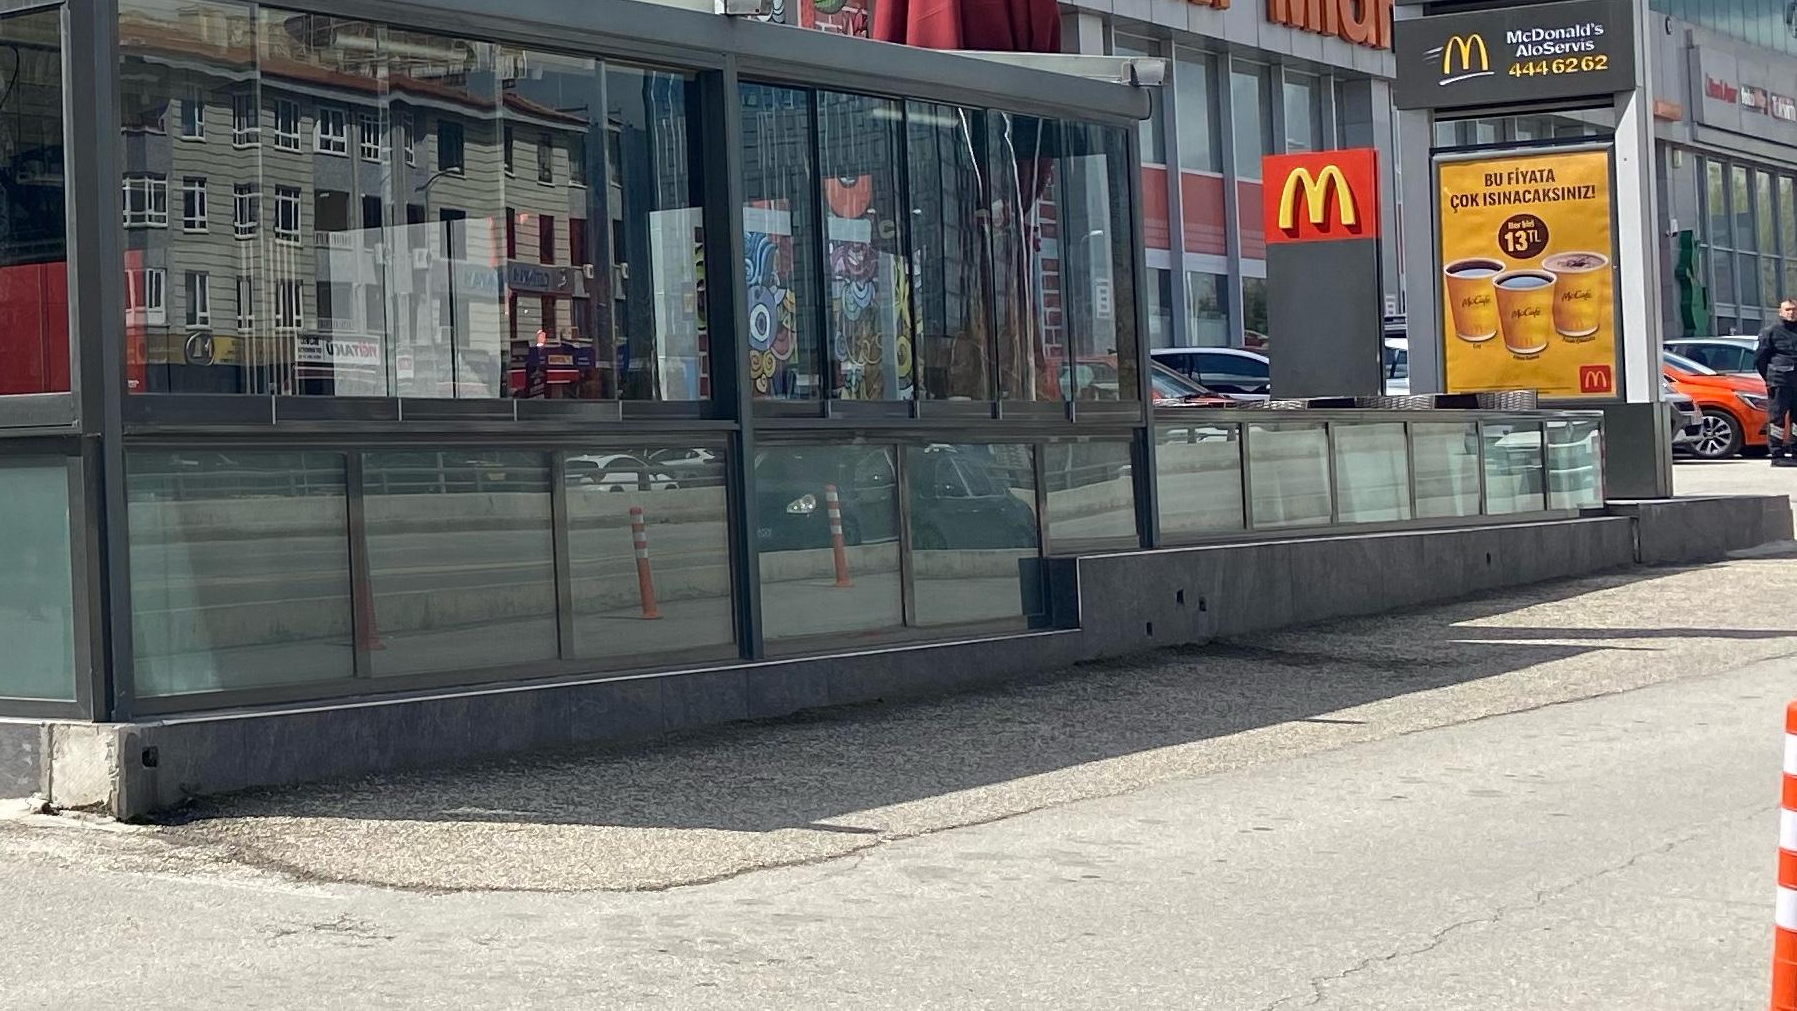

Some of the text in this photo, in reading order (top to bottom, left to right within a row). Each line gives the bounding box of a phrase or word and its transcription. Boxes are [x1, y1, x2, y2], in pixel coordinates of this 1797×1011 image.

[1506, 22, 1605, 45] McDonald's
[1515, 38, 1596, 58] AloServis
[1484, 167, 1556, 187] BU FİYATA
[1450, 185, 1596, 213] ÇOK ISINACAKSINIZ!
